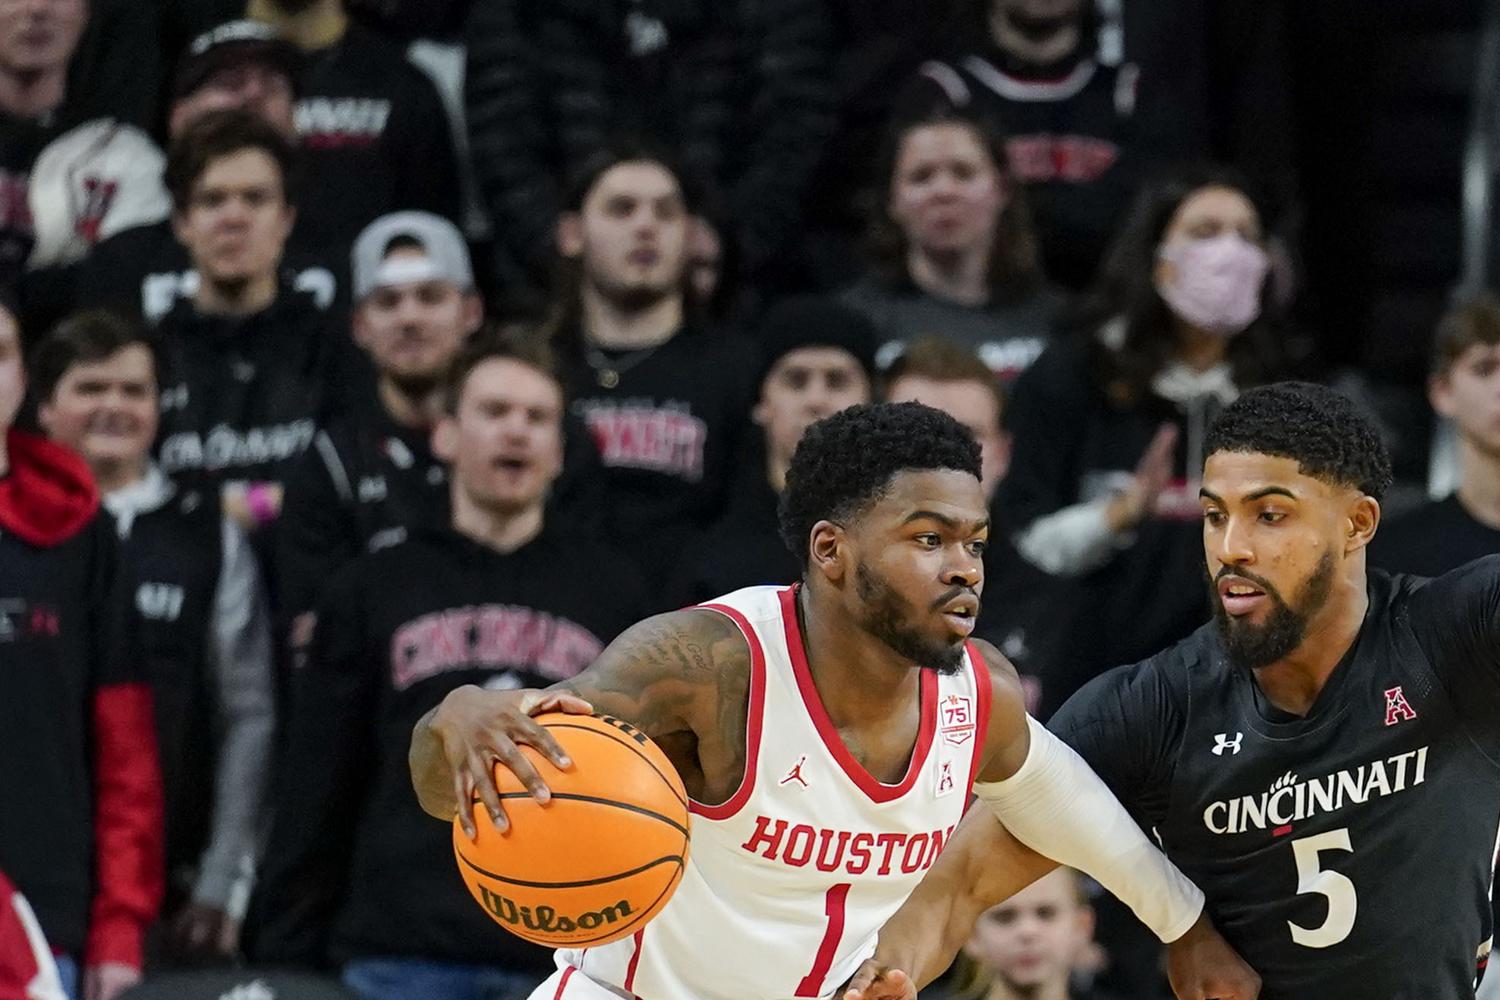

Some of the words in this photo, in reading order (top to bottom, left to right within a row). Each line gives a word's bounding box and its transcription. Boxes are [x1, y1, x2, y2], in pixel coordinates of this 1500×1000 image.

[390, 603, 606, 692] CINCINNAT
[945, 707, 967, 724] 75
[1203, 746, 1430, 835] CINCINNATI
[741, 815, 955, 876] HOUSTON
[1286, 827, 1358, 949] 5
[478, 883, 640, 933] Wilson
[794, 882, 852, 998] 1
